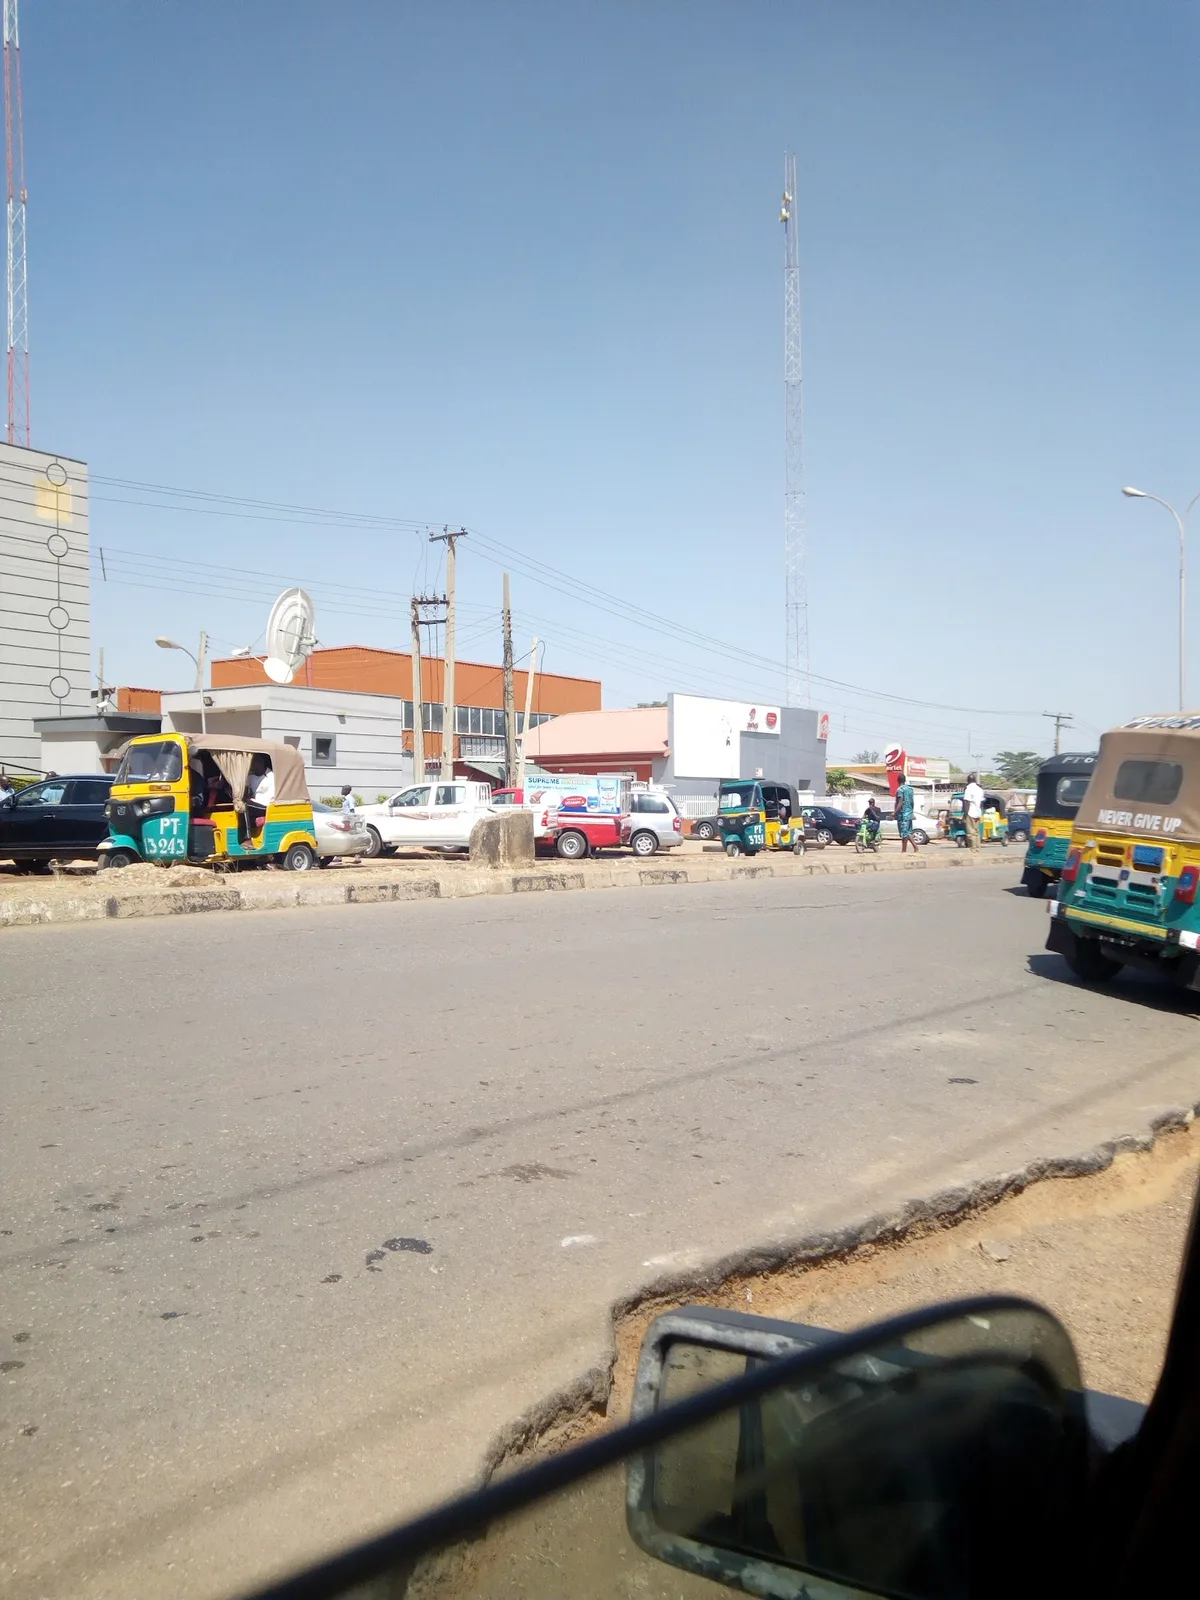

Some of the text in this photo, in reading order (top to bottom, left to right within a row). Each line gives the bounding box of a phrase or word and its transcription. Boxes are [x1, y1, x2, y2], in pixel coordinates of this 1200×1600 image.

[1097, 809, 1182, 833] NEVER GIVE UP
